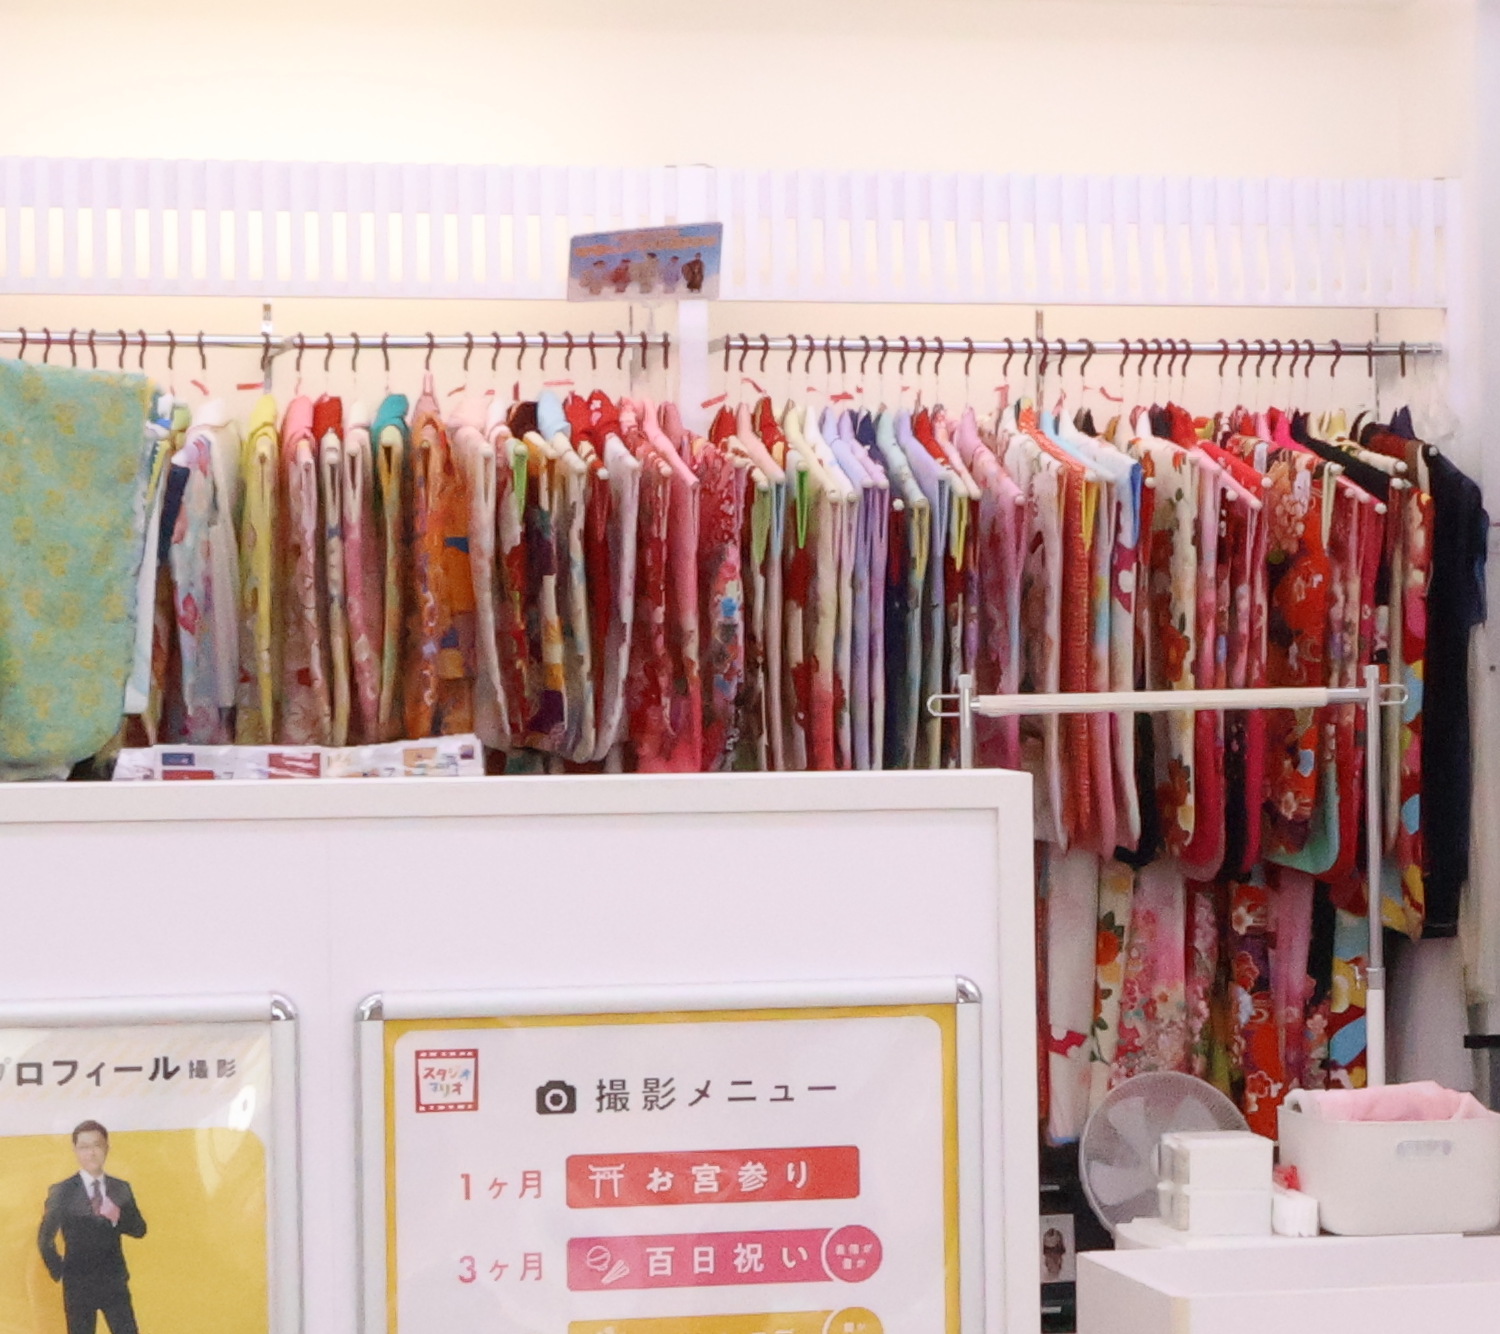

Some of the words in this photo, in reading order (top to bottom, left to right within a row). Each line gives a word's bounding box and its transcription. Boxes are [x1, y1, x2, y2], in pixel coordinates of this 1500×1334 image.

[422, 1066, 471, 1080] スタジオ
[428, 1080, 464, 1098] マリオ
[595, 1076, 837, 1113] 撮影メニュー
[646, 1160, 808, 1195] お宮参り
[645, 1242, 809, 1277] 百日祝い
